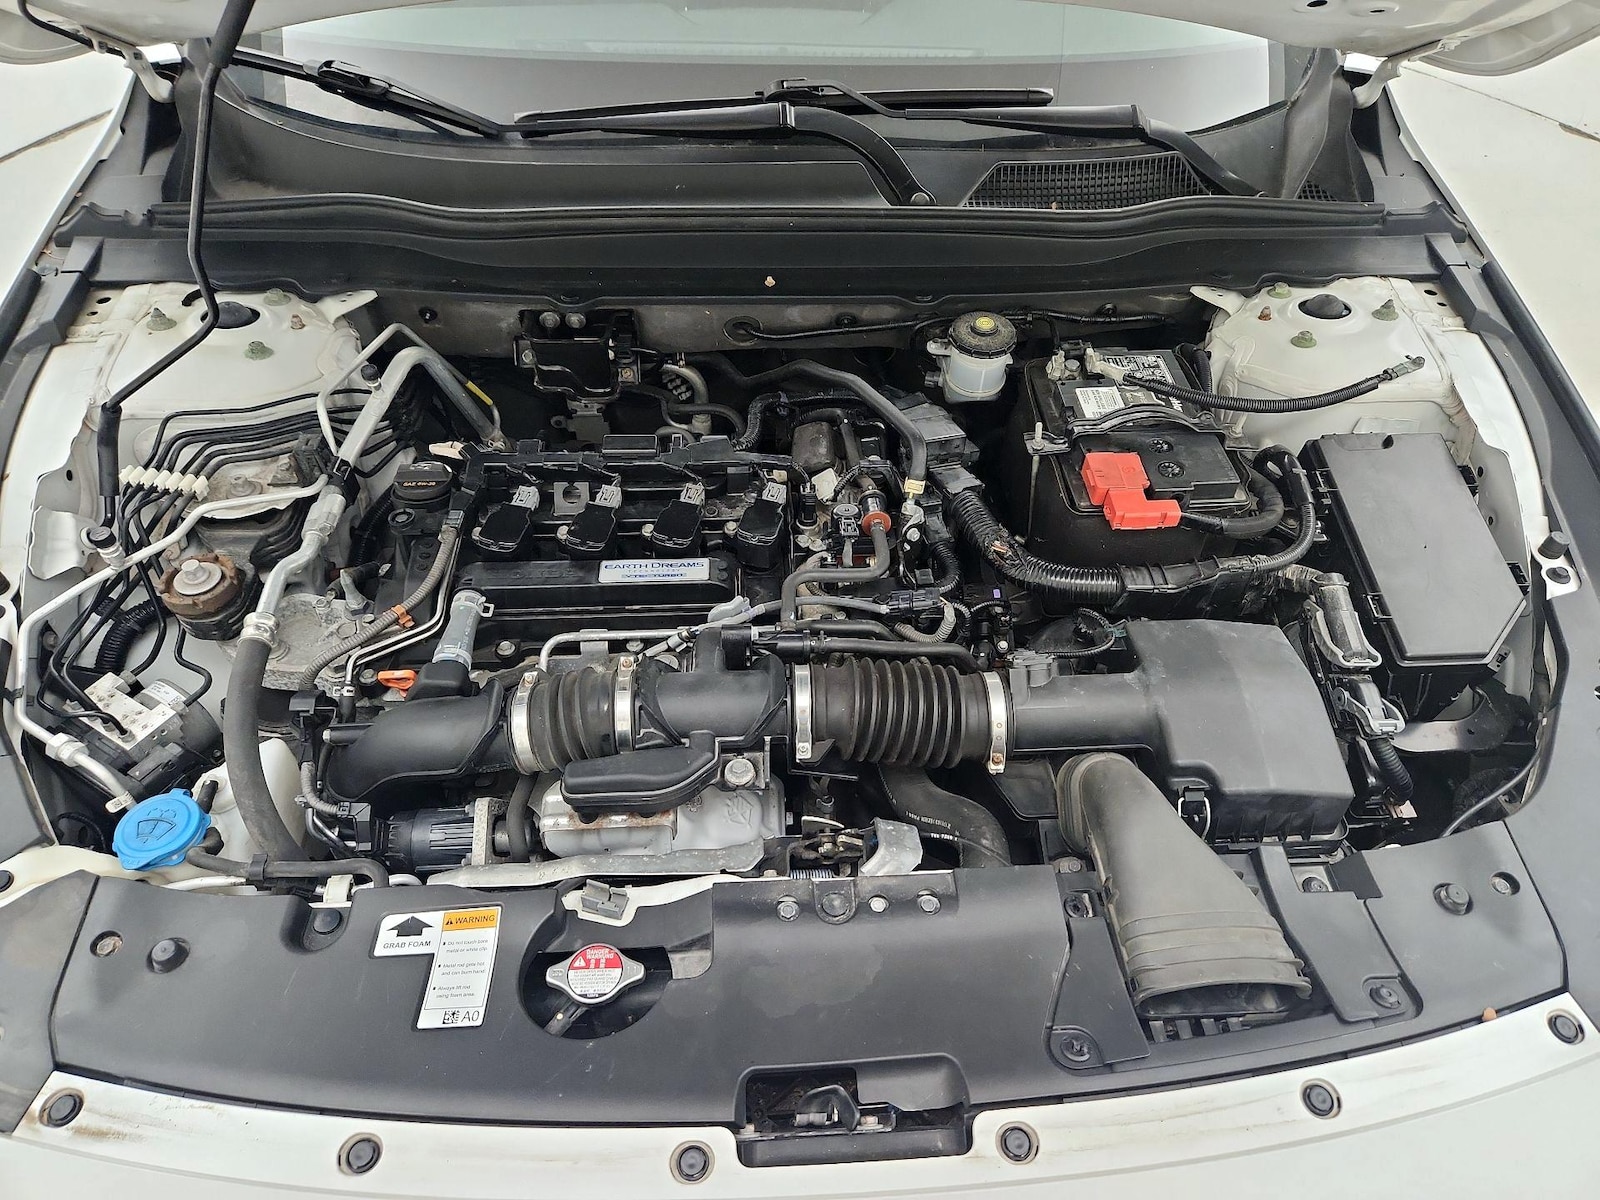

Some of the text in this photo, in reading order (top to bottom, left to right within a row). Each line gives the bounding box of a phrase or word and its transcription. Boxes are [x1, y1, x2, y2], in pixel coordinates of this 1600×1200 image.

[651, 561, 704, 569] DREAMS
[455, 914, 495, 925] WARNING
[461, 1010, 480, 1023] A0
